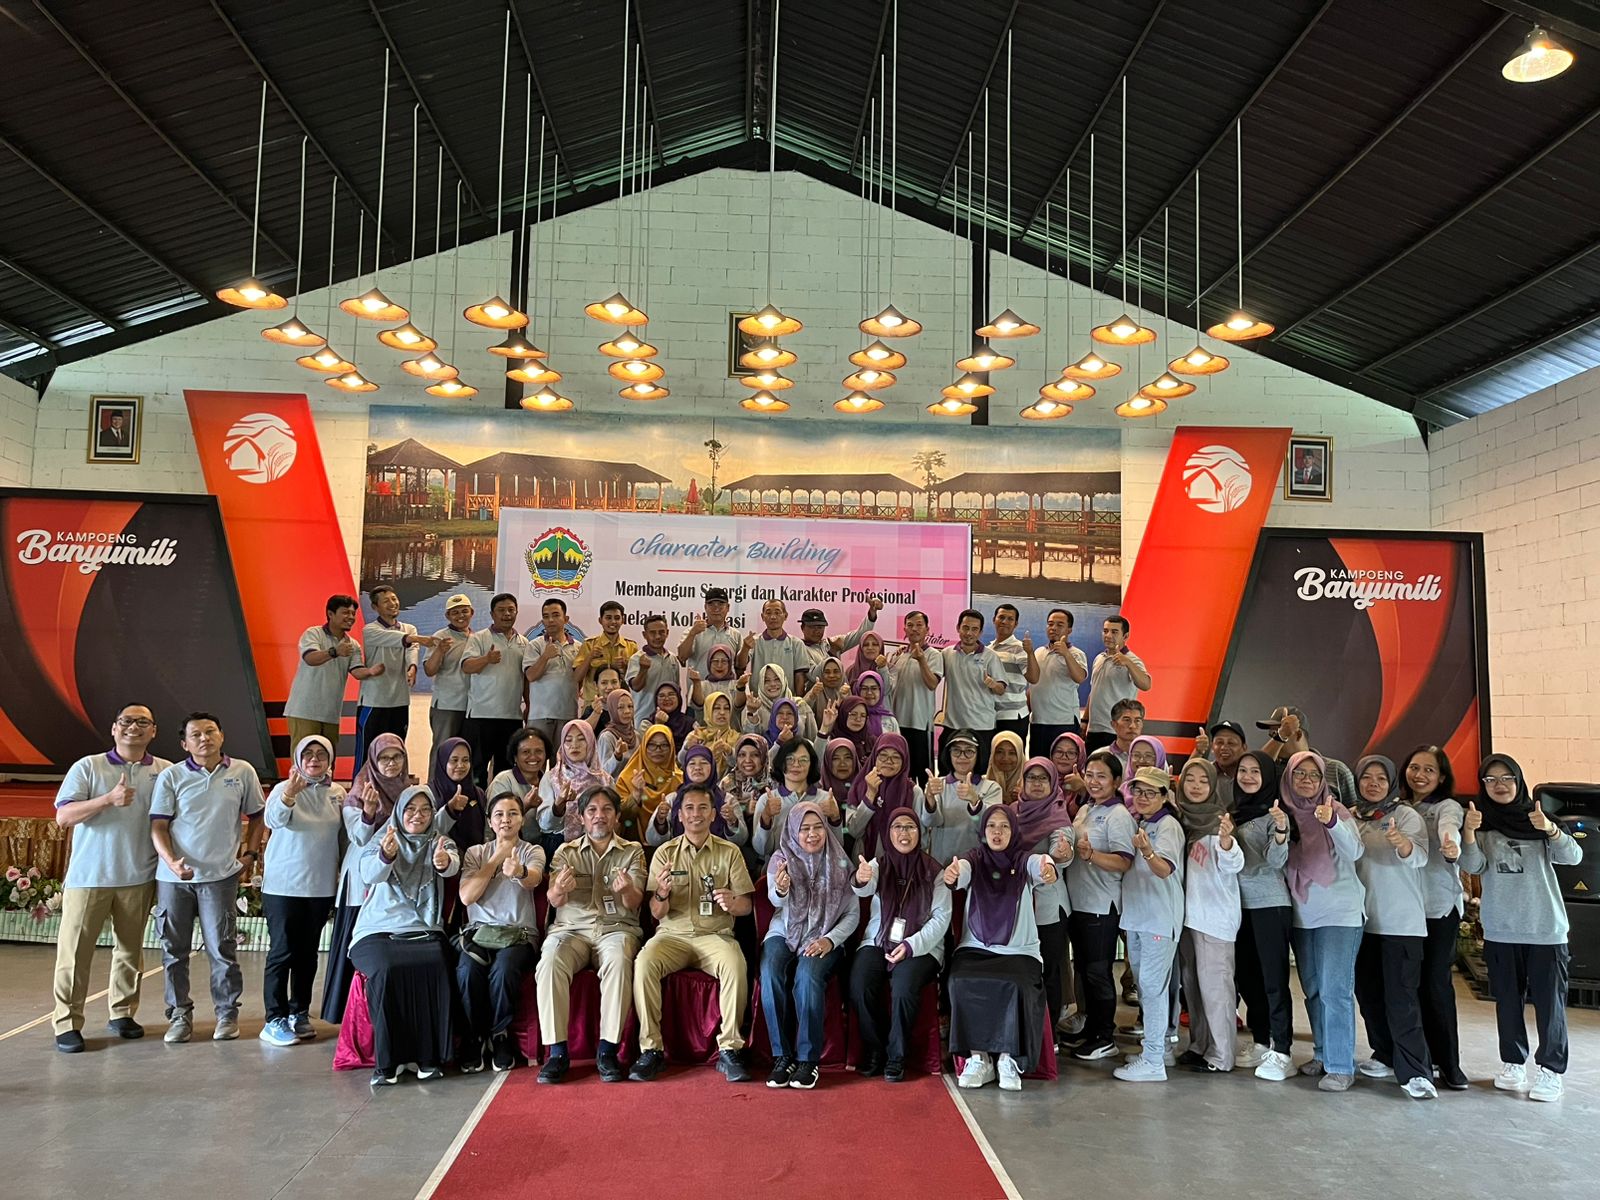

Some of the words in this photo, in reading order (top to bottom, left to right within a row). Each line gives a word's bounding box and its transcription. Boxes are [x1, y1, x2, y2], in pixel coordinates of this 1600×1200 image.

[56, 531, 137, 544] KAMPOENG
[16, 529, 178, 575] Banyumili
[630, 533, 737, 557] Character
[746, 537, 842, 574] Building
[1330, 569, 1404, 580] KAMPOENG
[615, 580, 695, 600] Membangun
[700, 583, 747, 603] Sergi
[751, 585, 775, 600] dan
[780, 586, 838, 602] Karakter
[842, 587, 916, 604] Profesional
[1293, 567, 1442, 610] Banyumili
[671, 611, 746, 629] Kolasi
